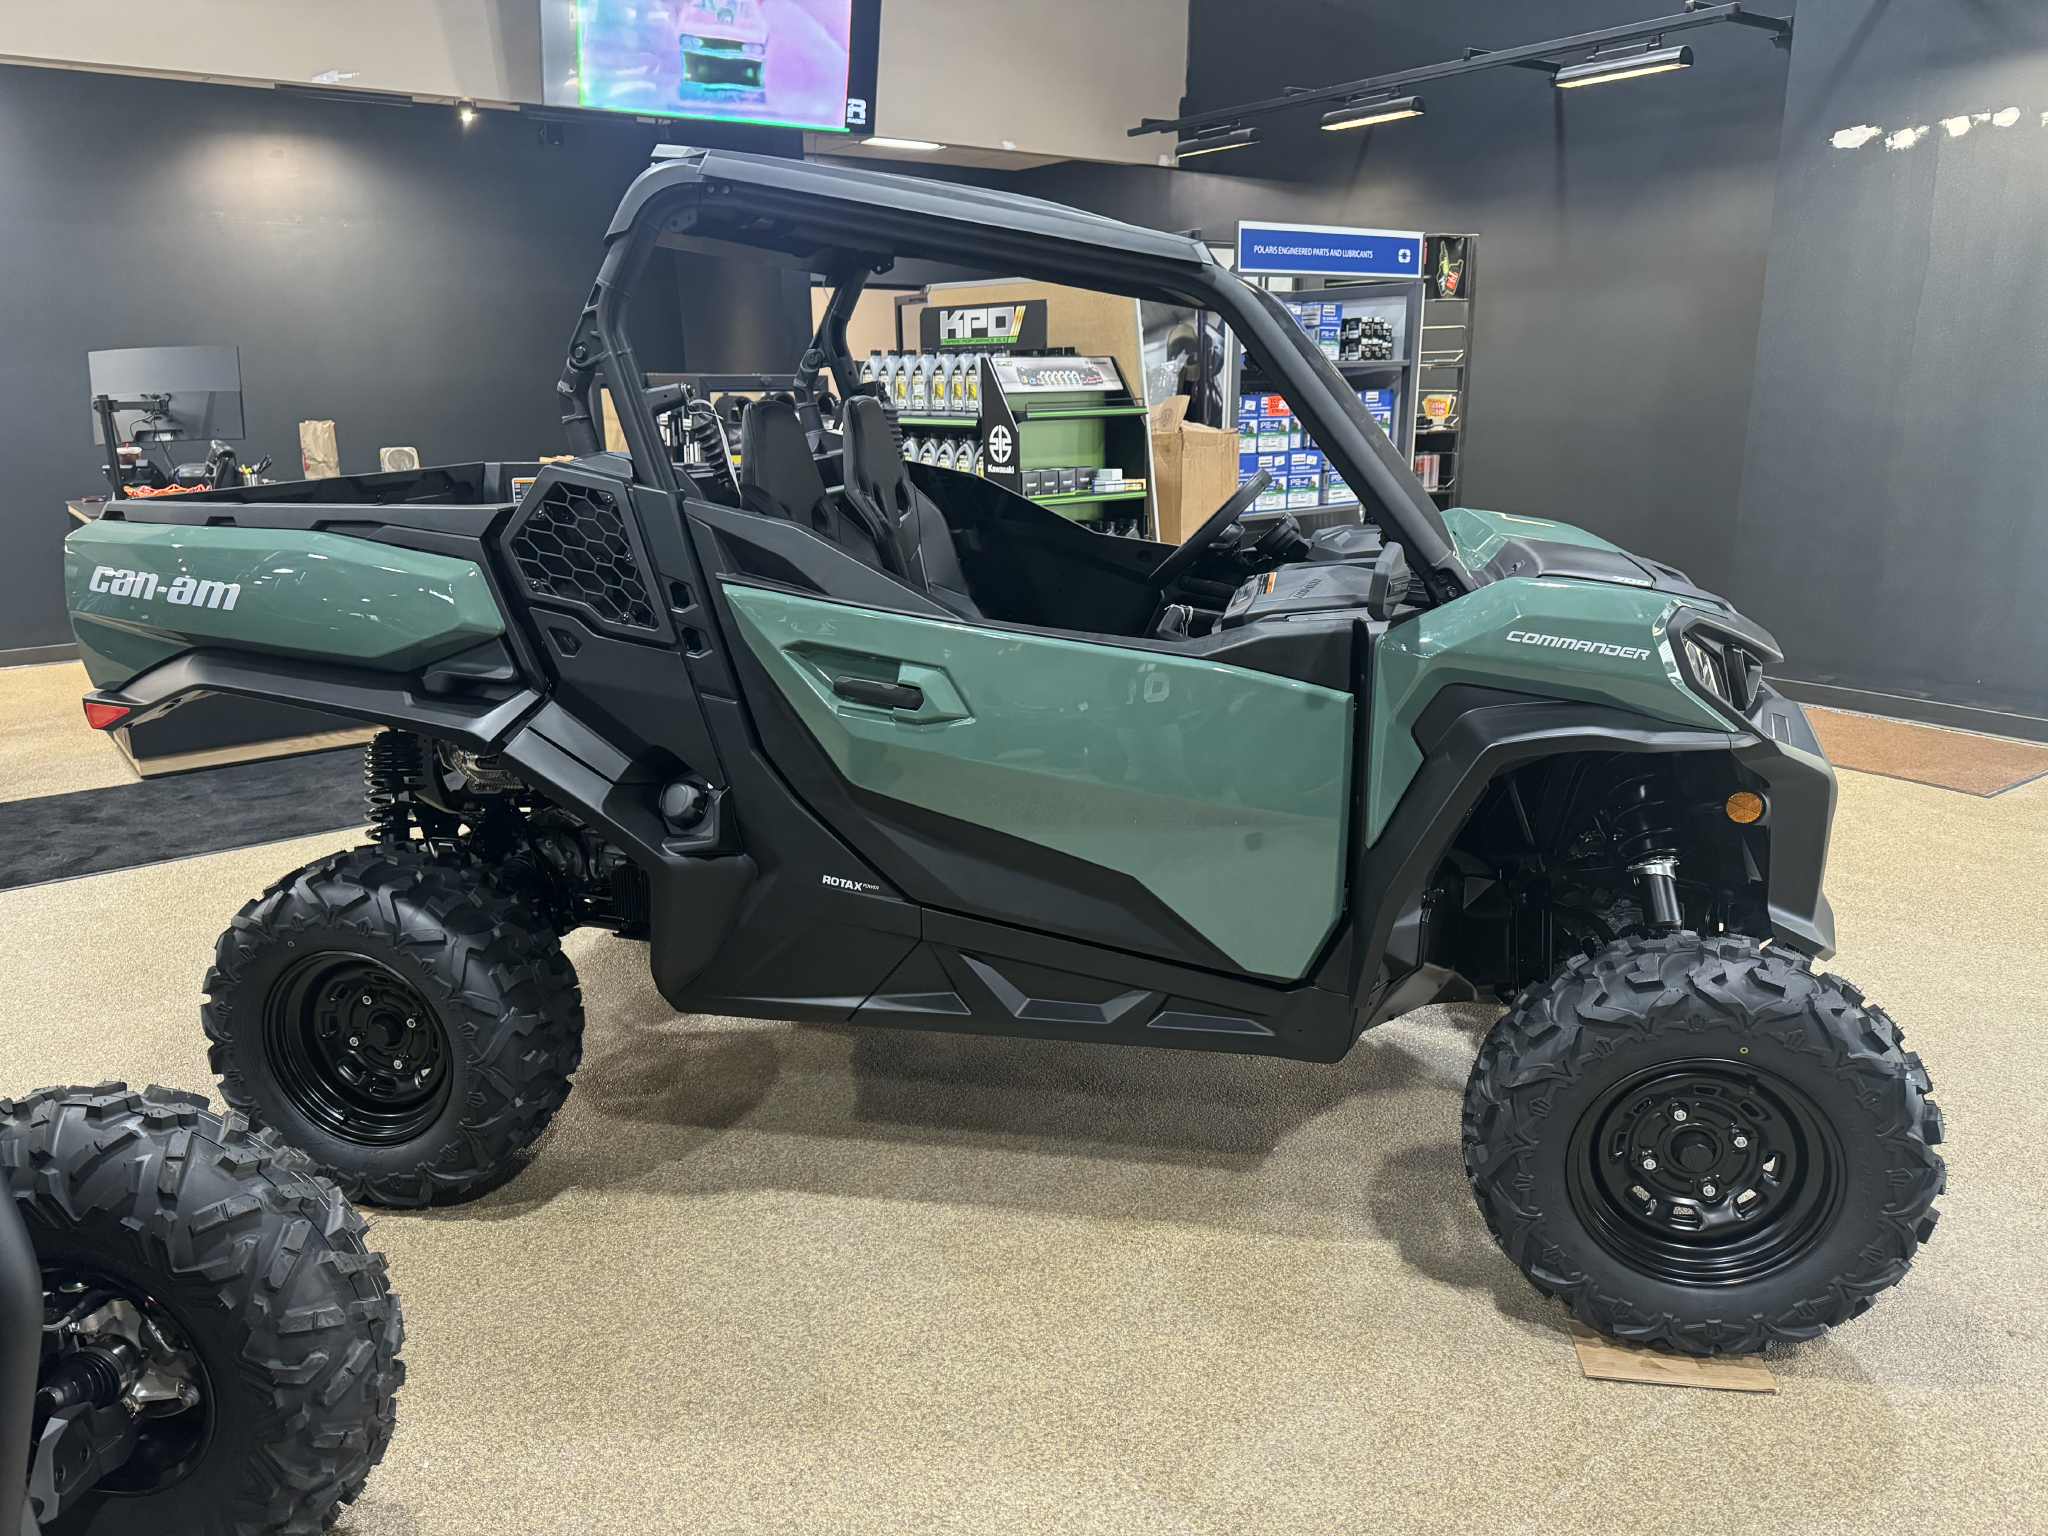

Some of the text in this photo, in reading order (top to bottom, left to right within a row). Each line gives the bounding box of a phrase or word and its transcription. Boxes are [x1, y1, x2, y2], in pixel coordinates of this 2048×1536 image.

[1253, 244, 1373, 259] POLARIS ENGINEERED PARTS AND LUBRICANTS
[940, 306, 1015, 339] KPO
[988, 464, 1015, 474] Kawasaki
[89, 565, 241, 611] can-am
[1506, 630, 1651, 661] COMMANDER
[822, 874, 863, 892] ROTAX
